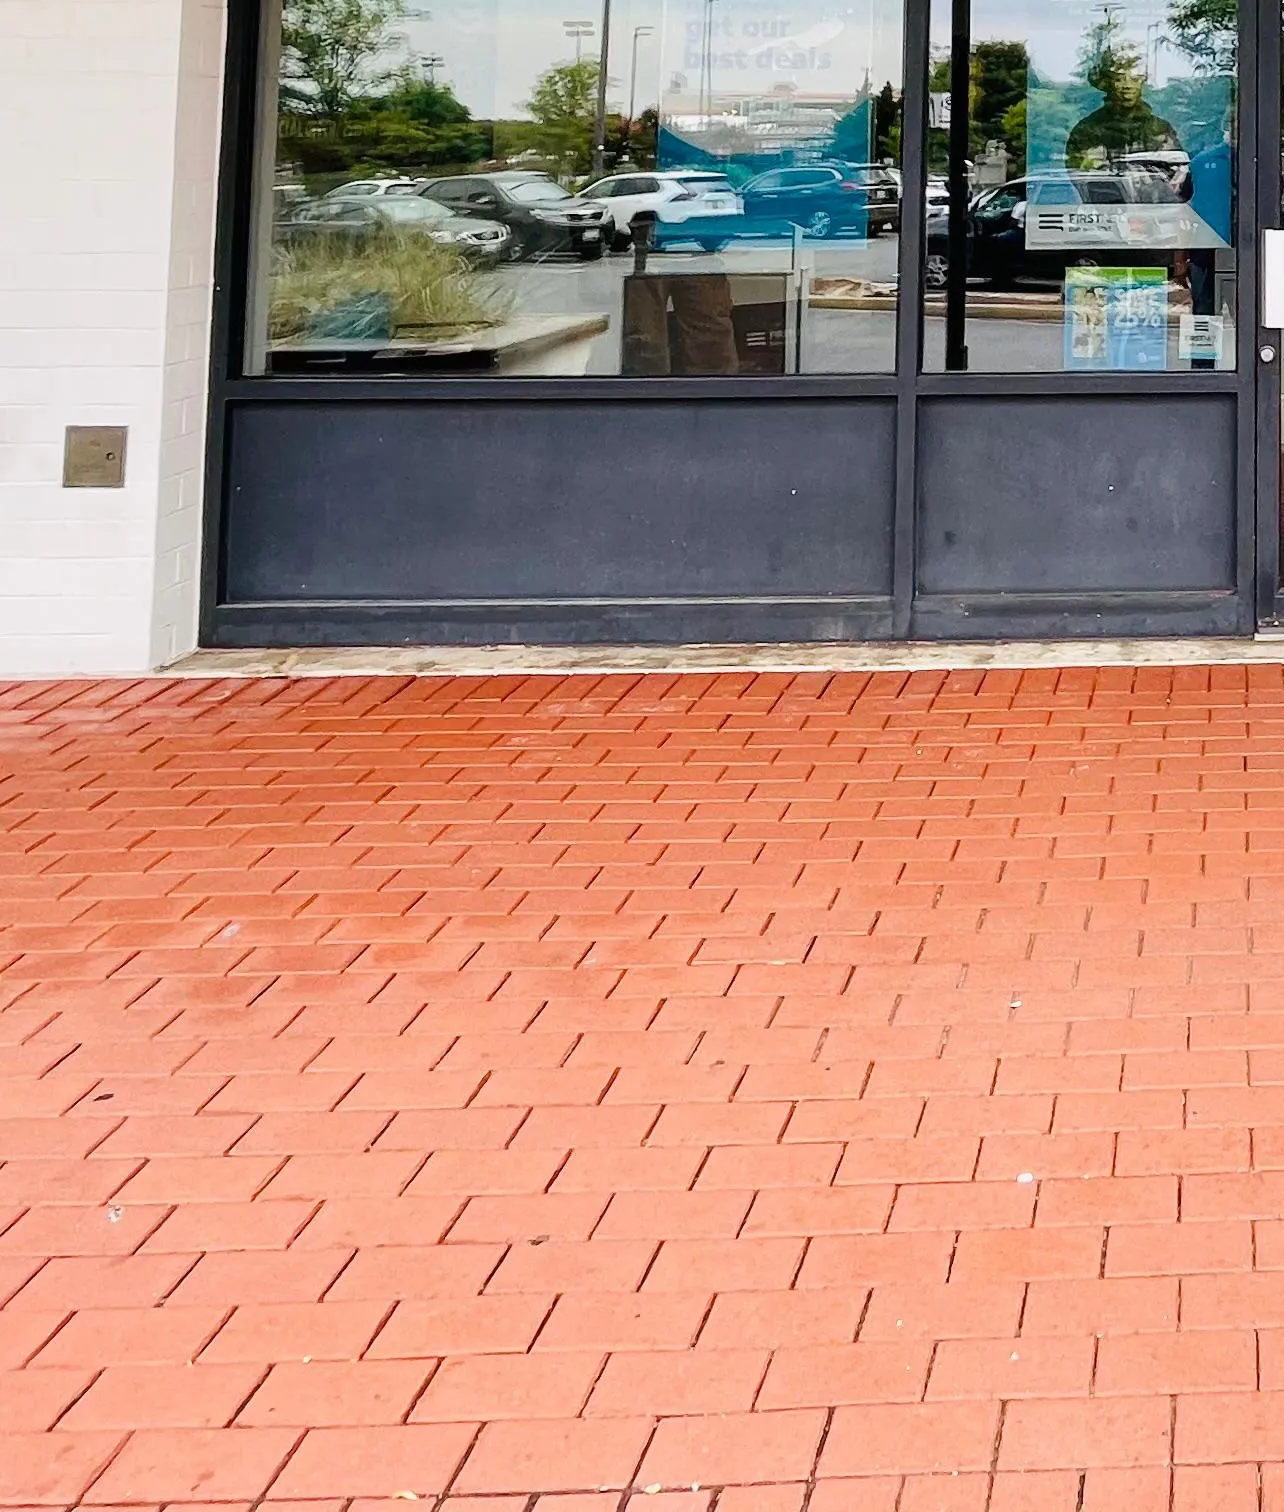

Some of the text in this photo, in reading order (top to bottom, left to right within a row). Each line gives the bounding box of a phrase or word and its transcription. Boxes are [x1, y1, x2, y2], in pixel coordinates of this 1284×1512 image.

[685, 17, 790, 41] get our
[684, 45, 833, 70] best deals
